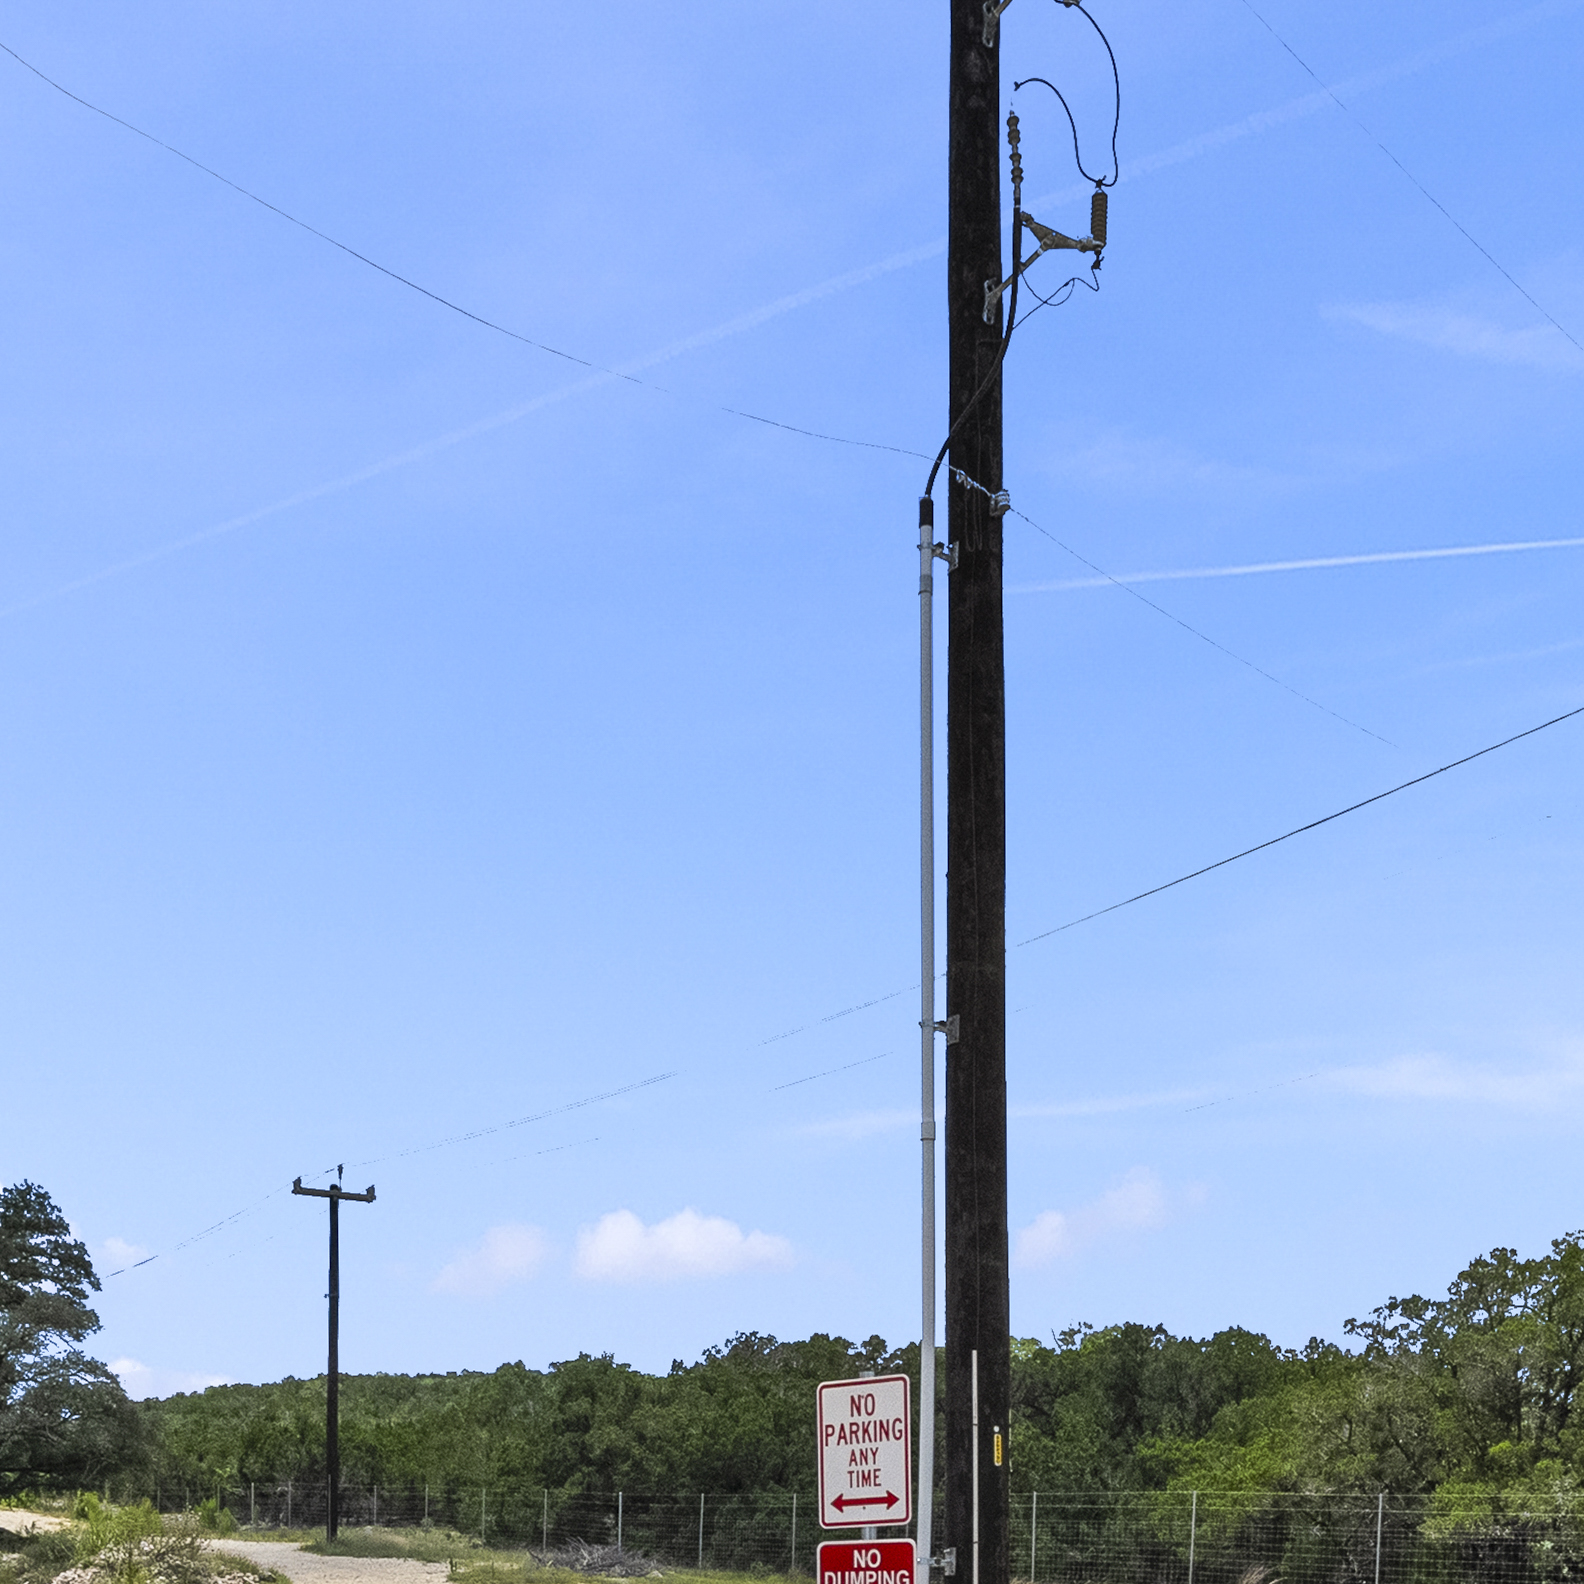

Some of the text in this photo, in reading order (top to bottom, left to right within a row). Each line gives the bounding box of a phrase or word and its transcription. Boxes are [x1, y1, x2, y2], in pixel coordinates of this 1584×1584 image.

[850, 1393, 875, 1417] NO
[825, 1417, 903, 1447] PARKING
[848, 1447, 879, 1467] ANY
[847, 1468, 882, 1488] TIME
[853, 1549, 882, 1569] NO
